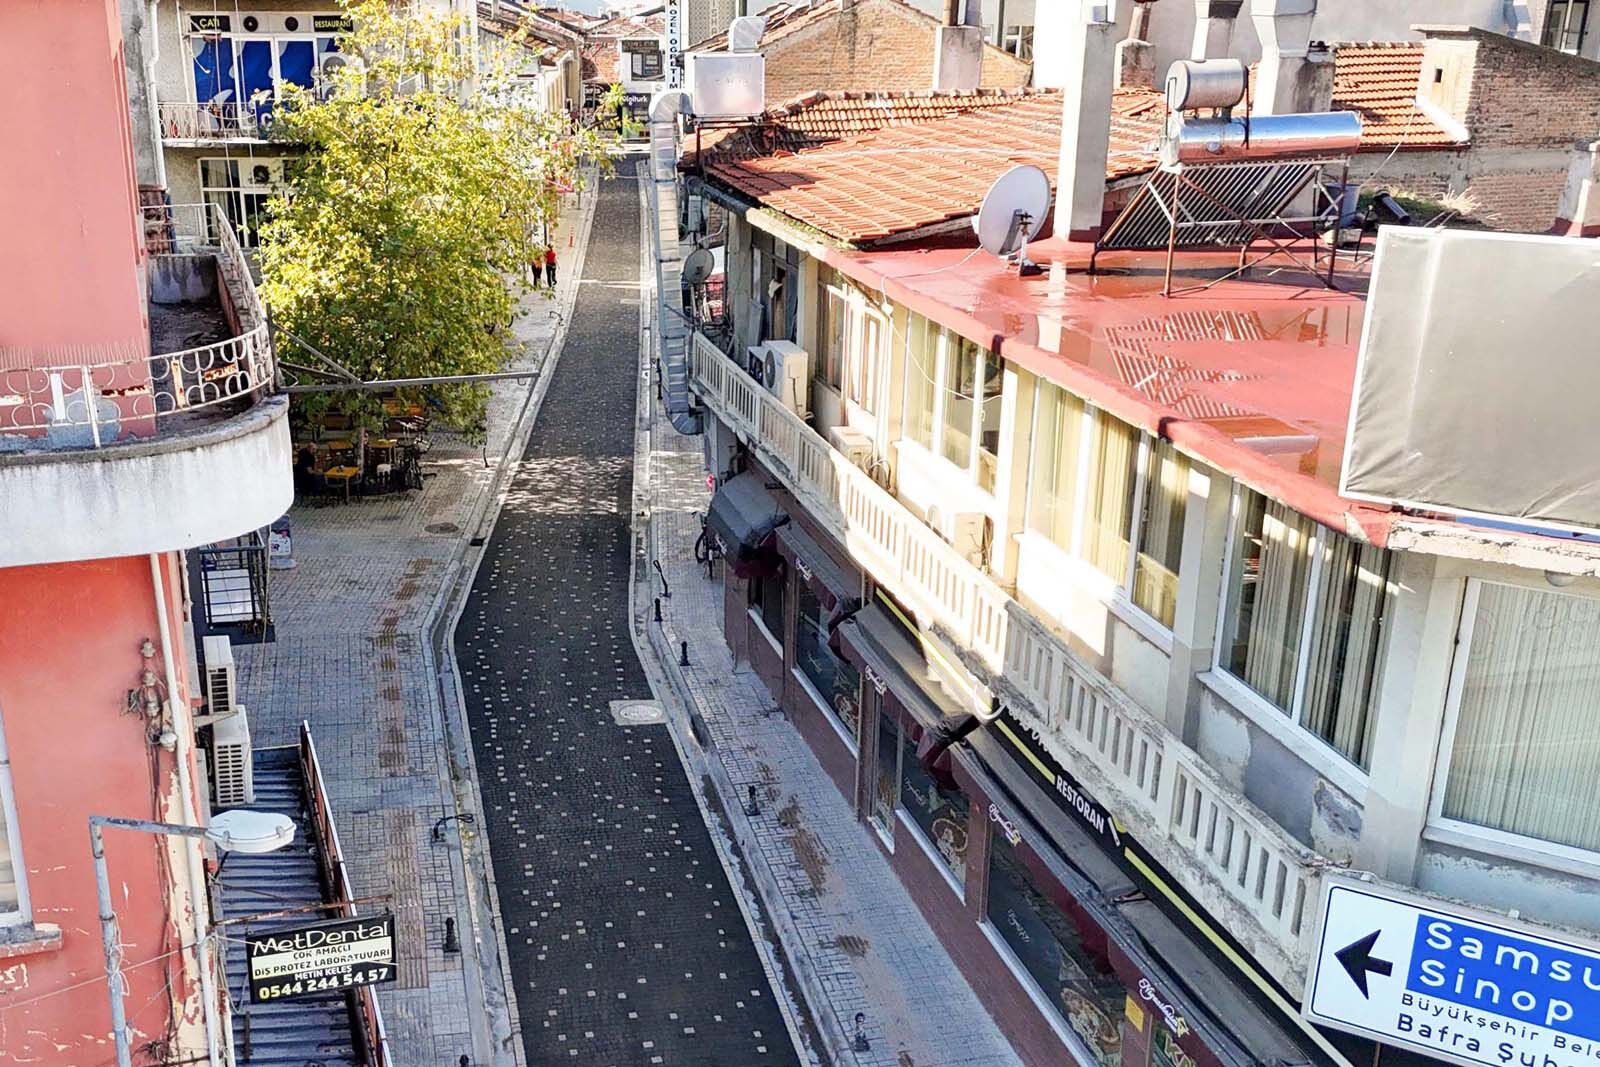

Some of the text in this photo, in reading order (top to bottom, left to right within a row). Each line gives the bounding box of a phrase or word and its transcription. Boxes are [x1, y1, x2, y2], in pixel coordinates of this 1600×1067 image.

[314, 19, 351, 28] RESTAURANT
[1056, 774, 1104, 834] RESTORAN
[252, 921, 388, 956] MetDental
[1425, 921, 1600, 991] Samsu
[255, 949, 390, 976] DİŞ PROTEZ LABORATUVARI
[258, 967, 388, 999] 0544 244 54 57
[325, 965, 352, 977] KELEŞ
[1419, 959, 1574, 1026] Sinop
[1402, 993, 1539, 1041] Büyükşehir
[1397, 1012, 1574, 1067] Bafra Şub
